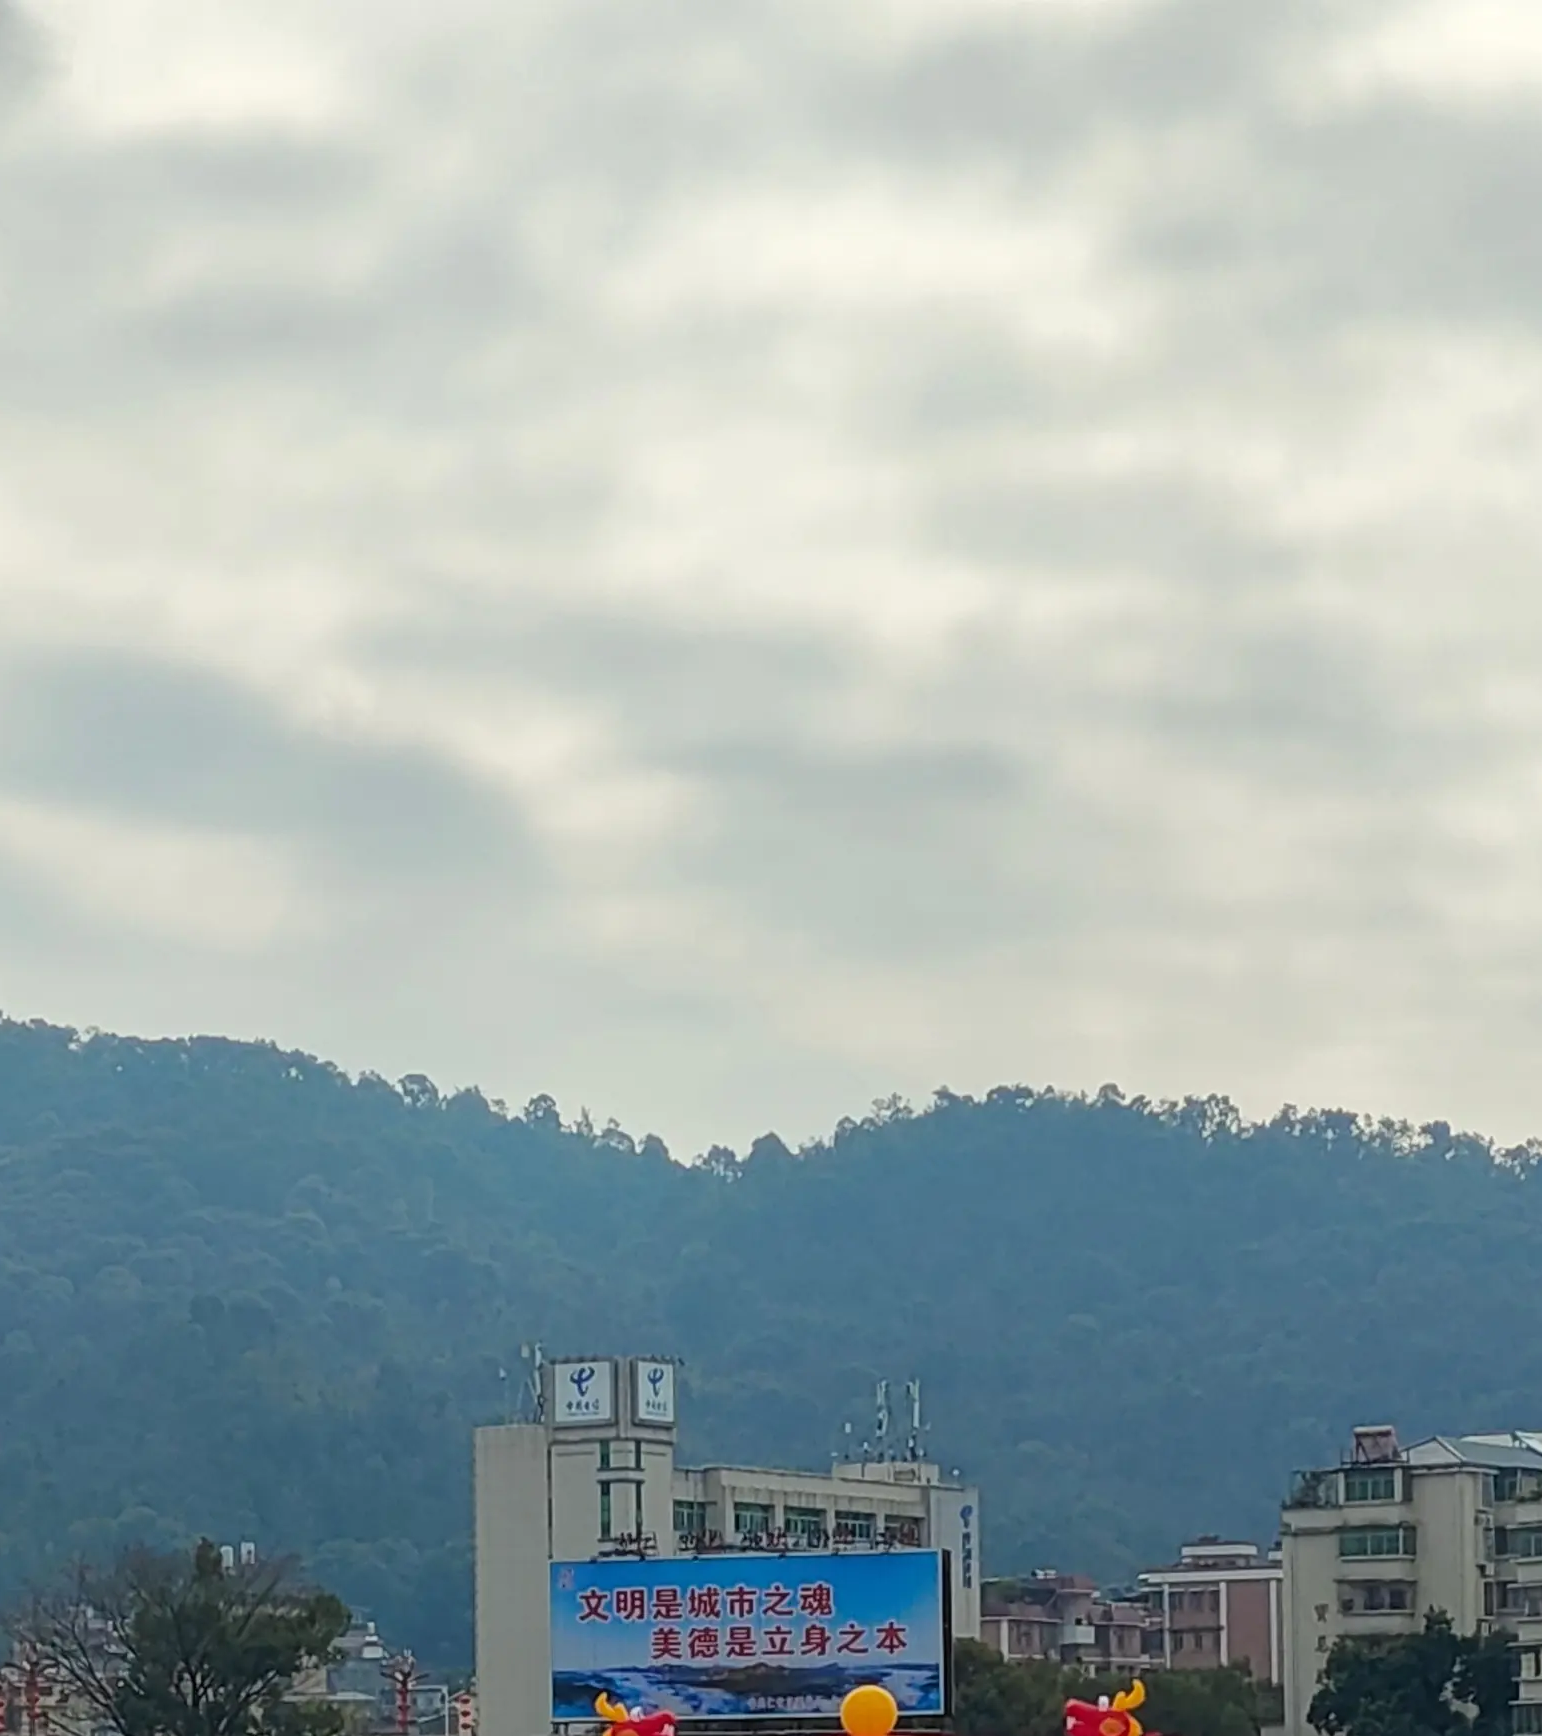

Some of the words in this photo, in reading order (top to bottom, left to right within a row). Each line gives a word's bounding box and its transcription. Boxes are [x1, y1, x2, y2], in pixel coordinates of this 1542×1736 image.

[577, 1583, 835, 1622] 文明是城市之魂
[650, 1621, 908, 1660] 美德是立身之本
